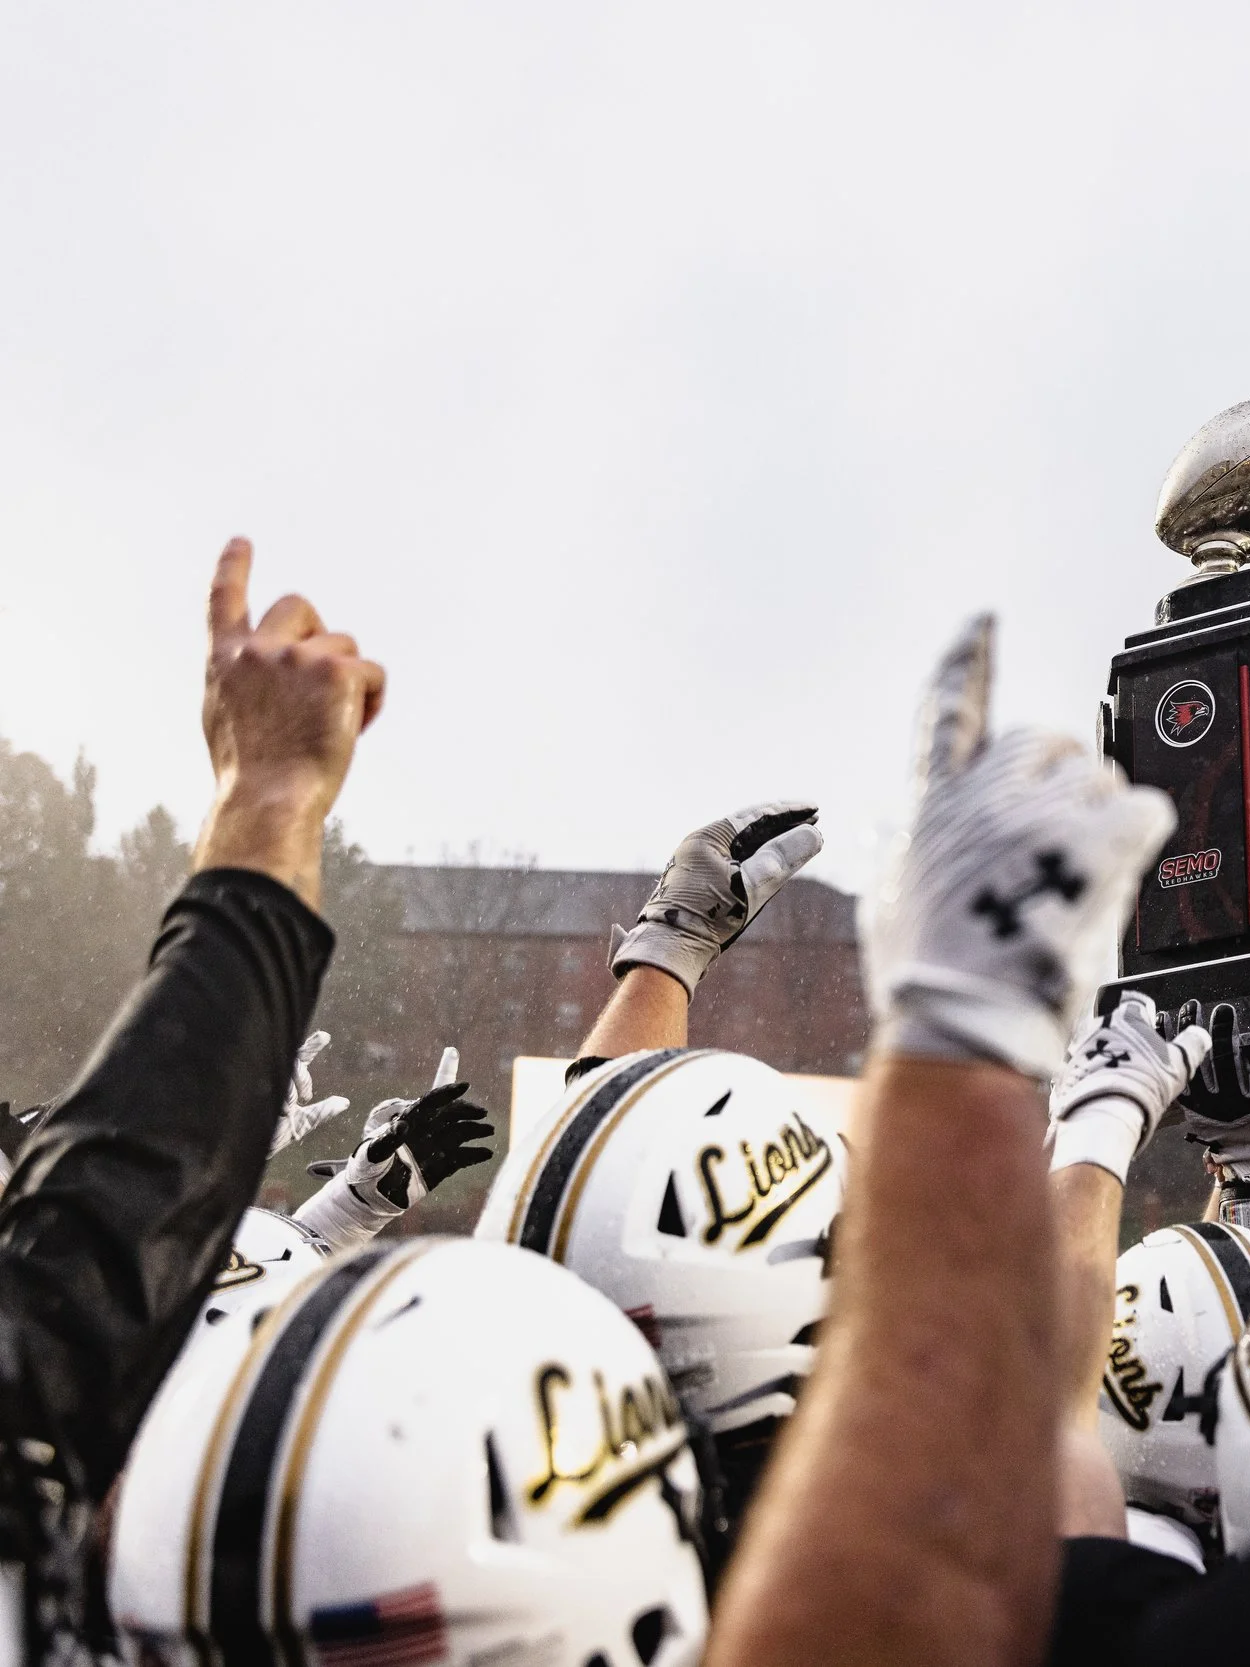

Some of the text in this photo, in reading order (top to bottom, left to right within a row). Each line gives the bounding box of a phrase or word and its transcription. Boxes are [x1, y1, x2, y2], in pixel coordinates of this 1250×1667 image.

[1161, 852, 1218, 879] SEMO
[1165, 870, 1213, 886] REDHAWKS
[696, 1110, 833, 1253] Lions
[525, 1360, 689, 1528] Lion
